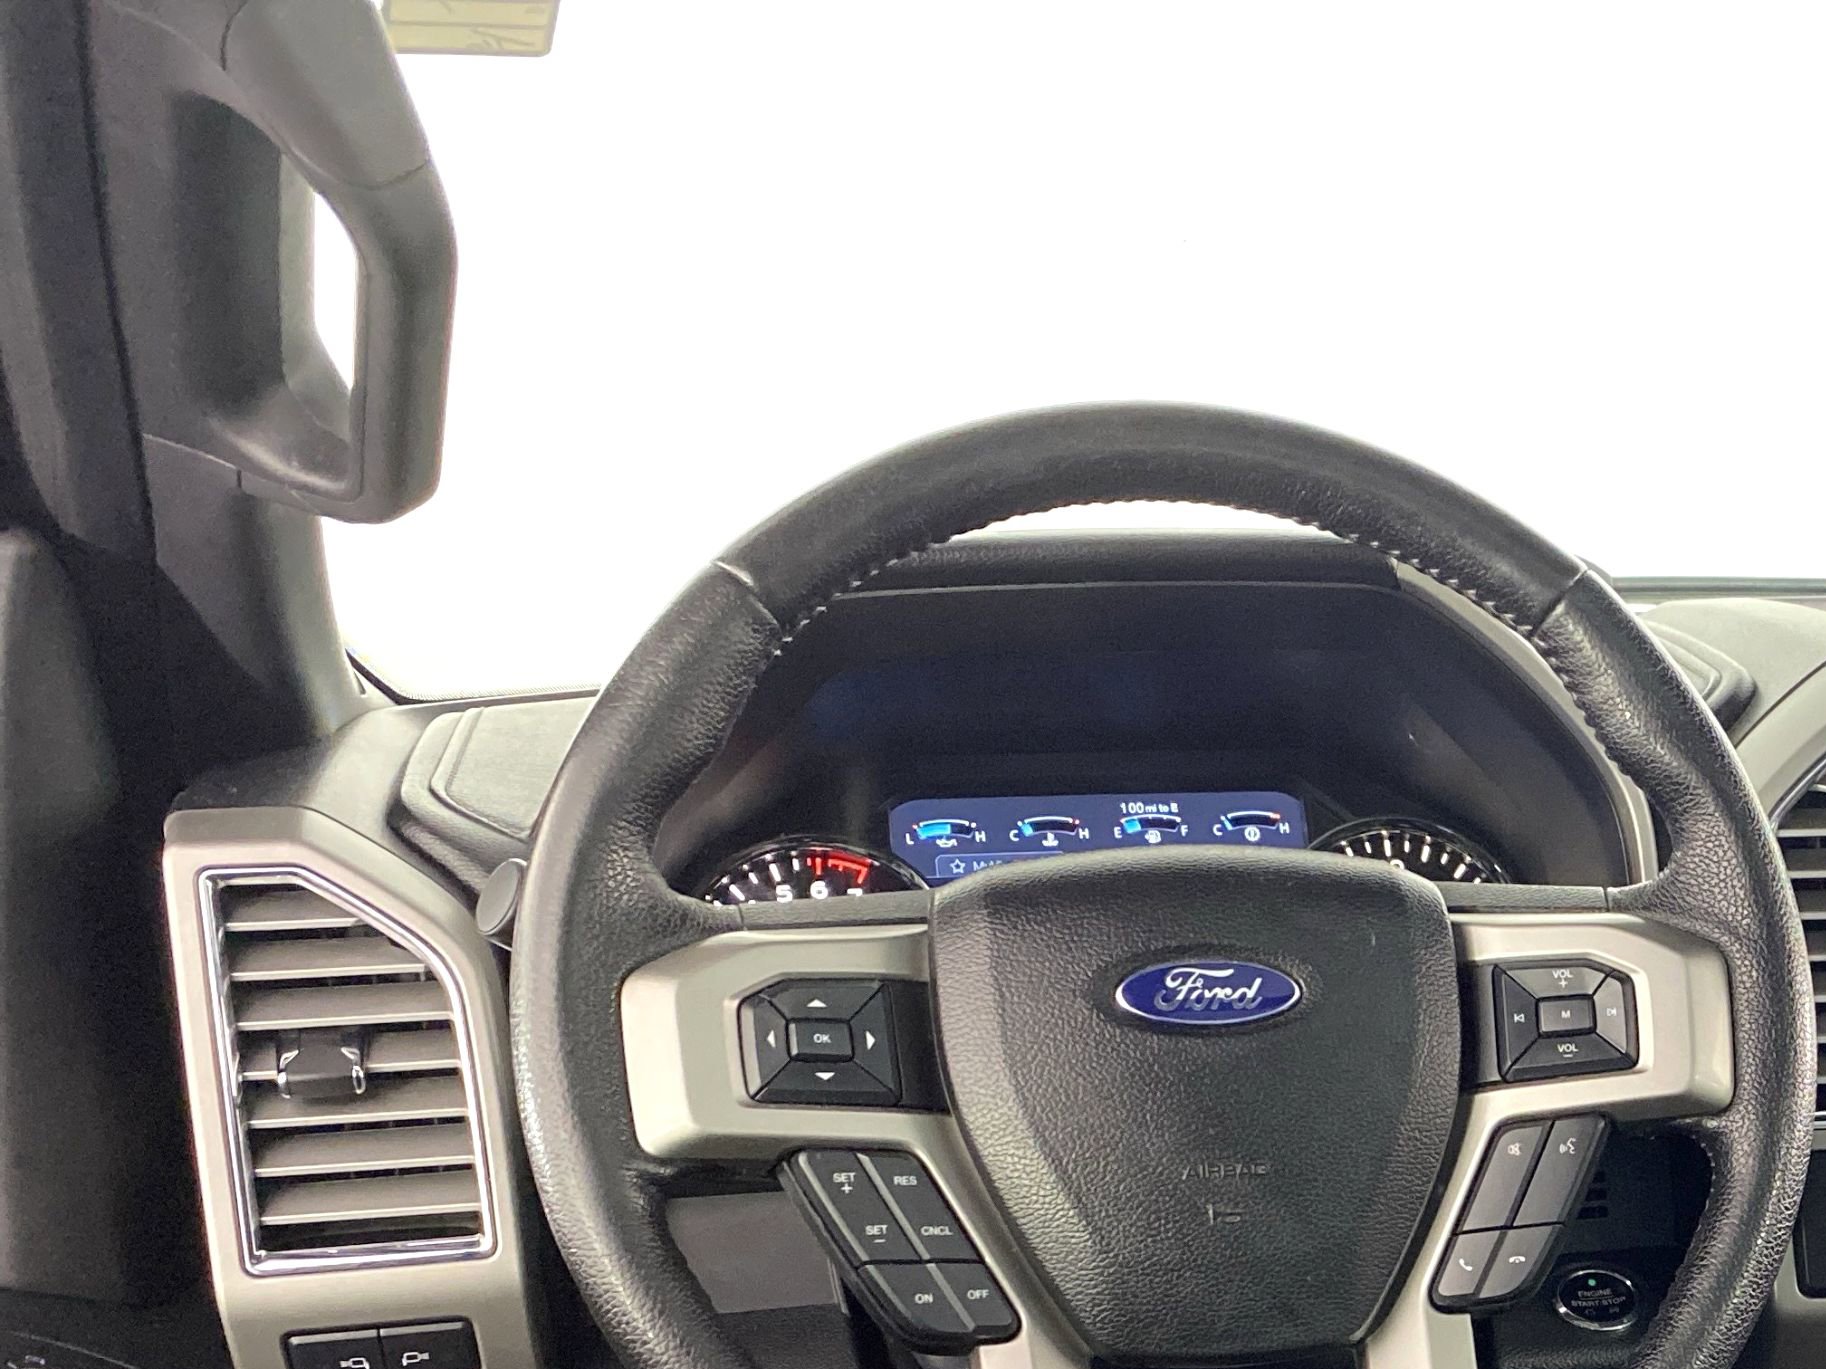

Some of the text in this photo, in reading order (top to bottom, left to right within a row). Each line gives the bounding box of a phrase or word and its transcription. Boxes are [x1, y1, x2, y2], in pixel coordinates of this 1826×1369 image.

[1119, 802, 1145, 814] 100
[1078, 828, 1090, 840] H
[1113, 827, 1122, 839] E
[1180, 825, 1189, 837] F
[1212, 824, 1223, 836] C
[1279, 822, 1290, 834] H
[905, 833, 914, 845] L
[975, 831, 986, 843] H
[1009, 830, 1019, 842] C
[775, 884, 794, 903] 5
[810, 879, 829, 899] 6
[1552, 969, 1573, 979] VOL
[1153, 967, 1265, 1012] Ford
[1561, 1010, 1571, 1019] M
[813, 1034, 831, 1044] OK
[1558, 1043, 1579, 1053] VOL
[832, 1173, 856, 1184] SET
[893, 1175, 917, 1186] RES
[865, 1225, 888, 1235] SET
[921, 1225, 954, 1237] CNCL
[915, 1293, 933, 1304] ON
[967, 1288, 990, 1300] OFF
